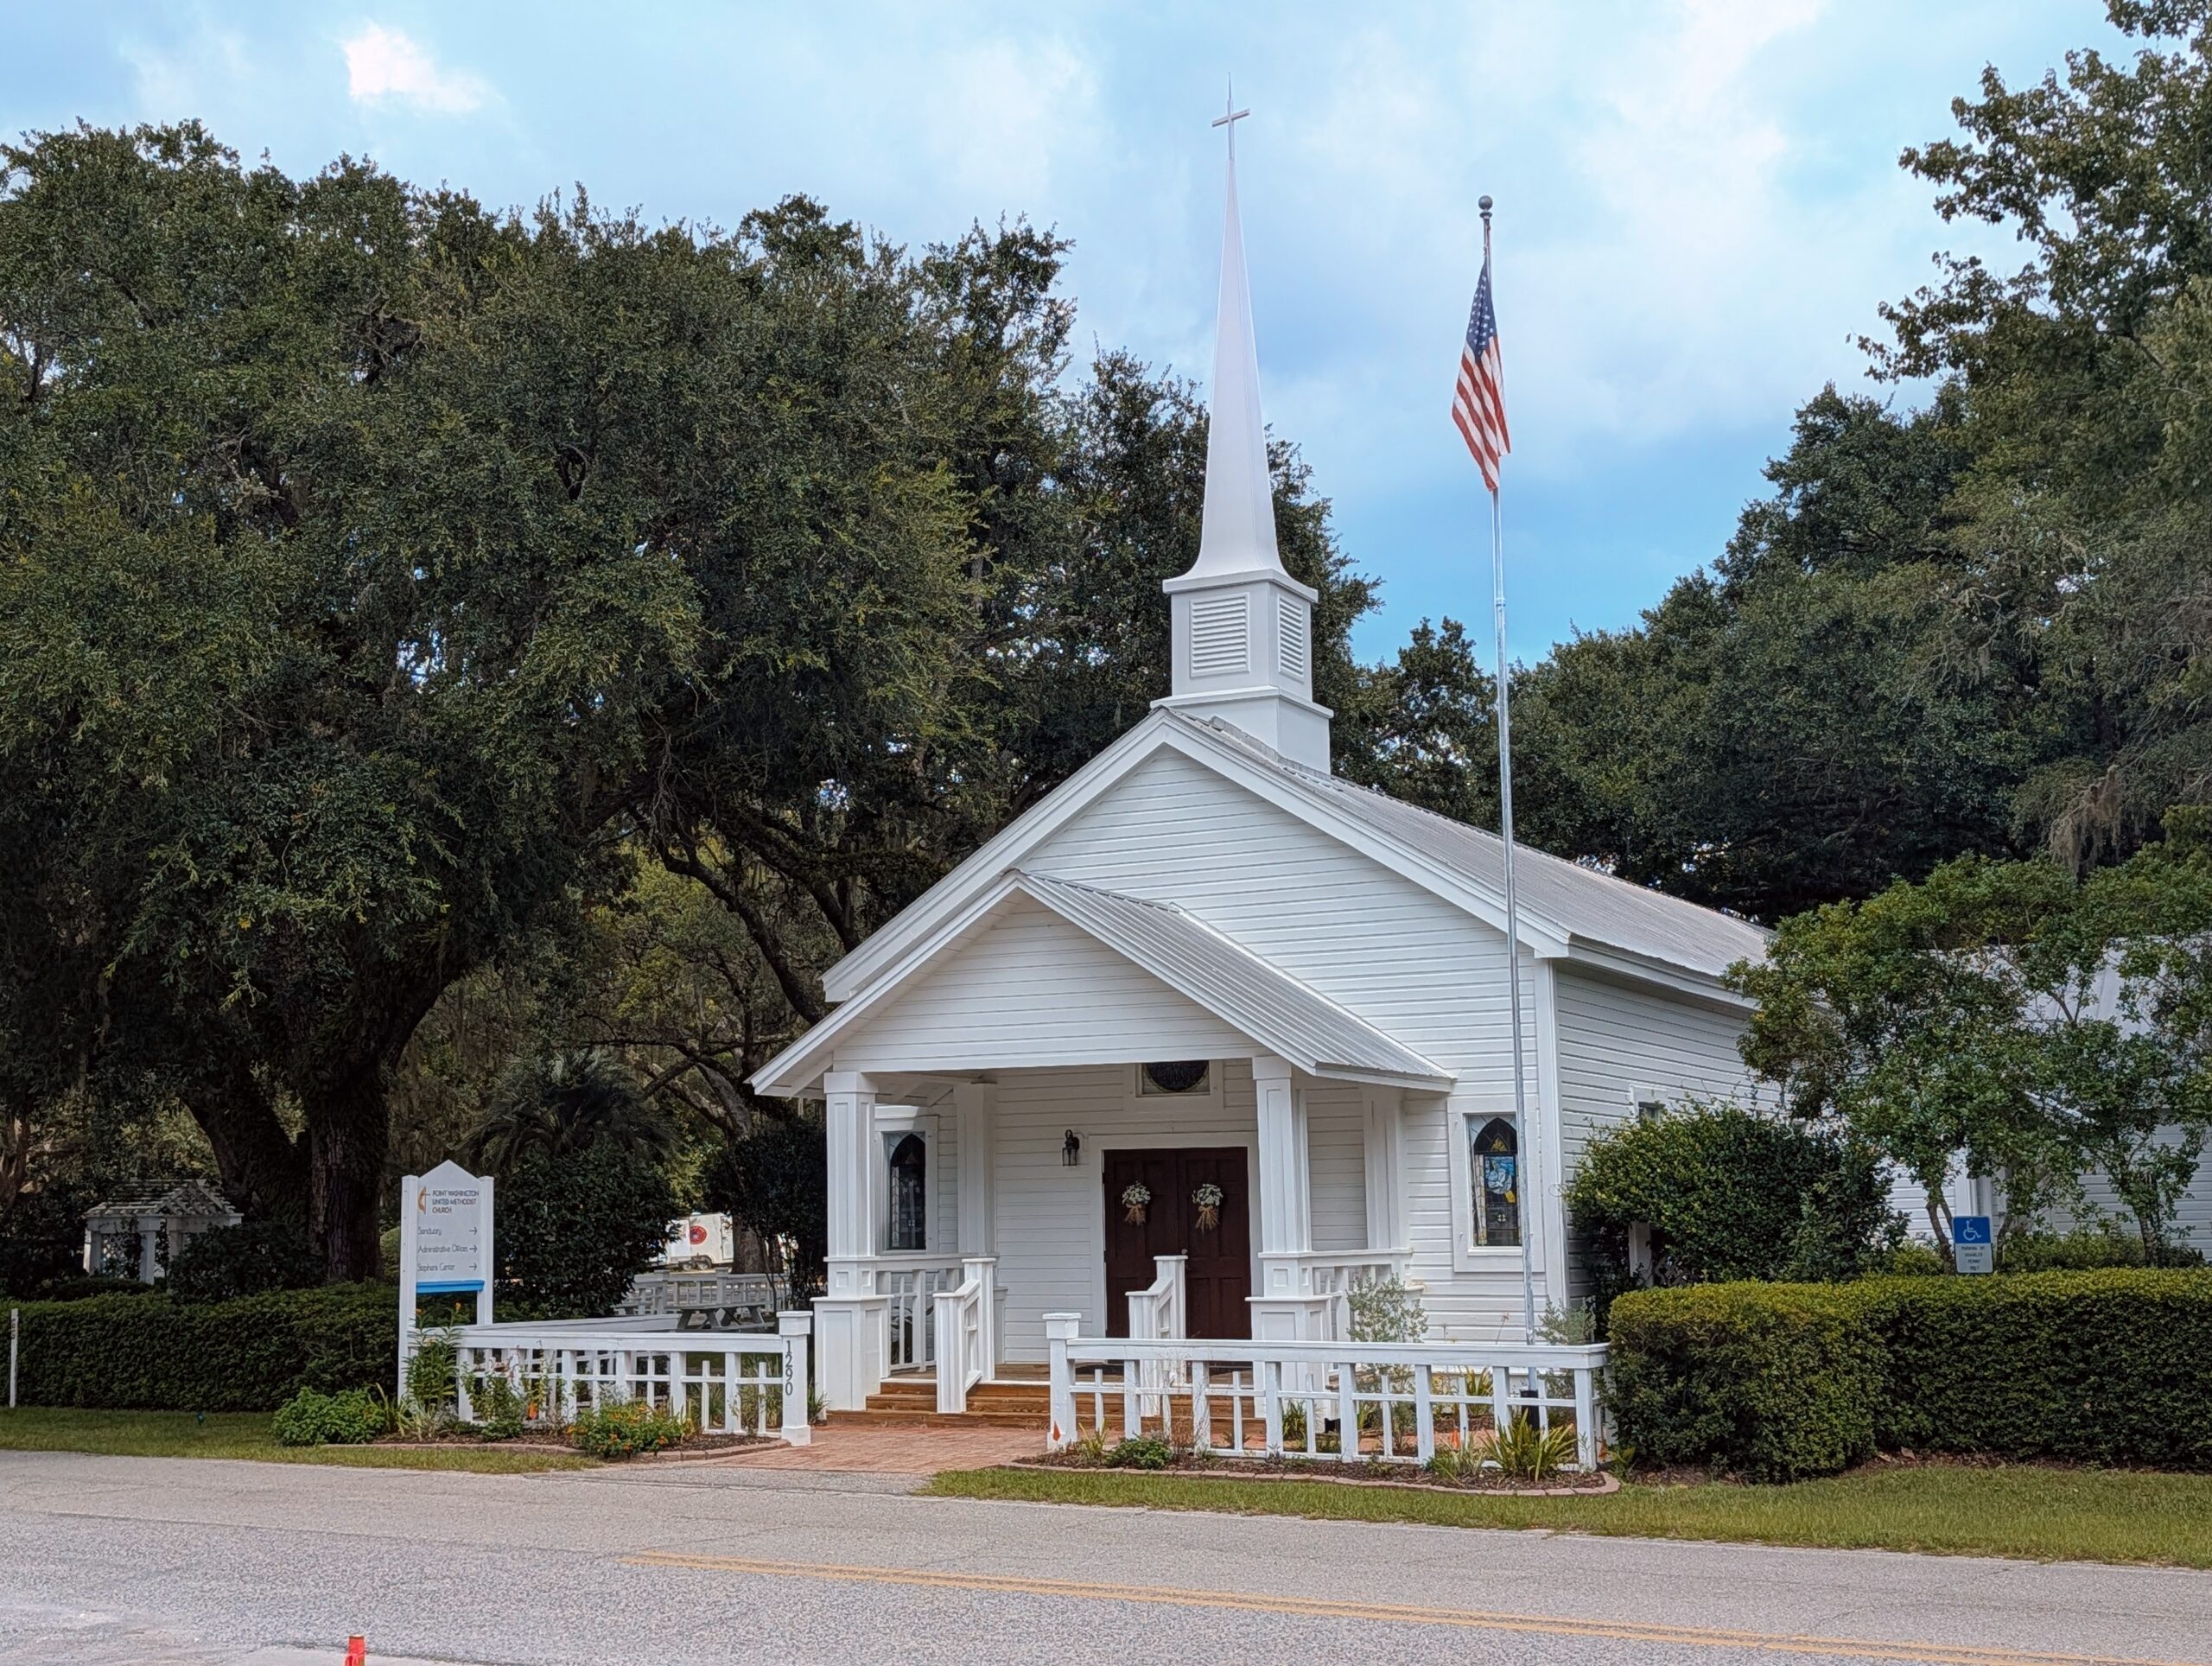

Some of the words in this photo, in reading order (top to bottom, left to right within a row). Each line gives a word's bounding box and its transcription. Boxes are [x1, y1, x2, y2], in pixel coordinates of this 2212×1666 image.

[417, 1226, 442, 1236] Sanctuary
[418, 1244, 450, 1253] Administrative
[439, 1262, 455, 1271] Center
[785, 1339, 793, 1396] 1290
